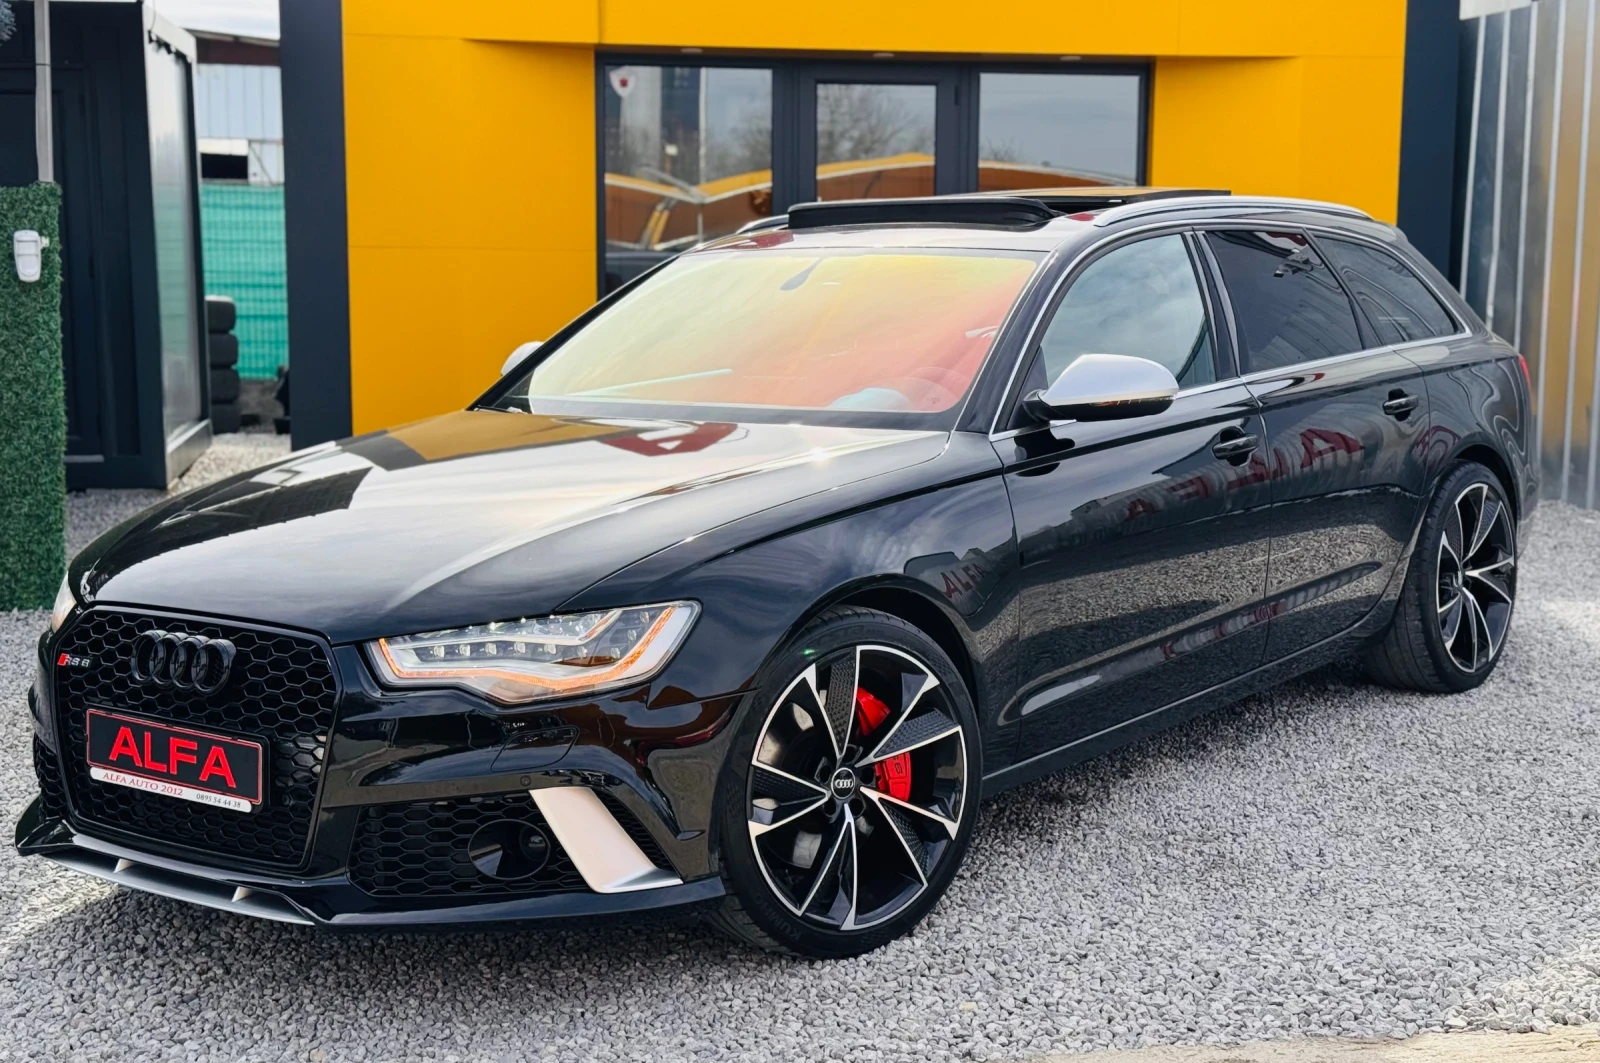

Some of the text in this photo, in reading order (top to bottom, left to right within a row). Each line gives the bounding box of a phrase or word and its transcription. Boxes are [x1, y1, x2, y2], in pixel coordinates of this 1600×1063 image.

[108, 725, 237, 788] ALFA
[102, 771, 184, 797] ALFA AUTO 2012
[196, 792, 242, 809] 0895 54 44 38
